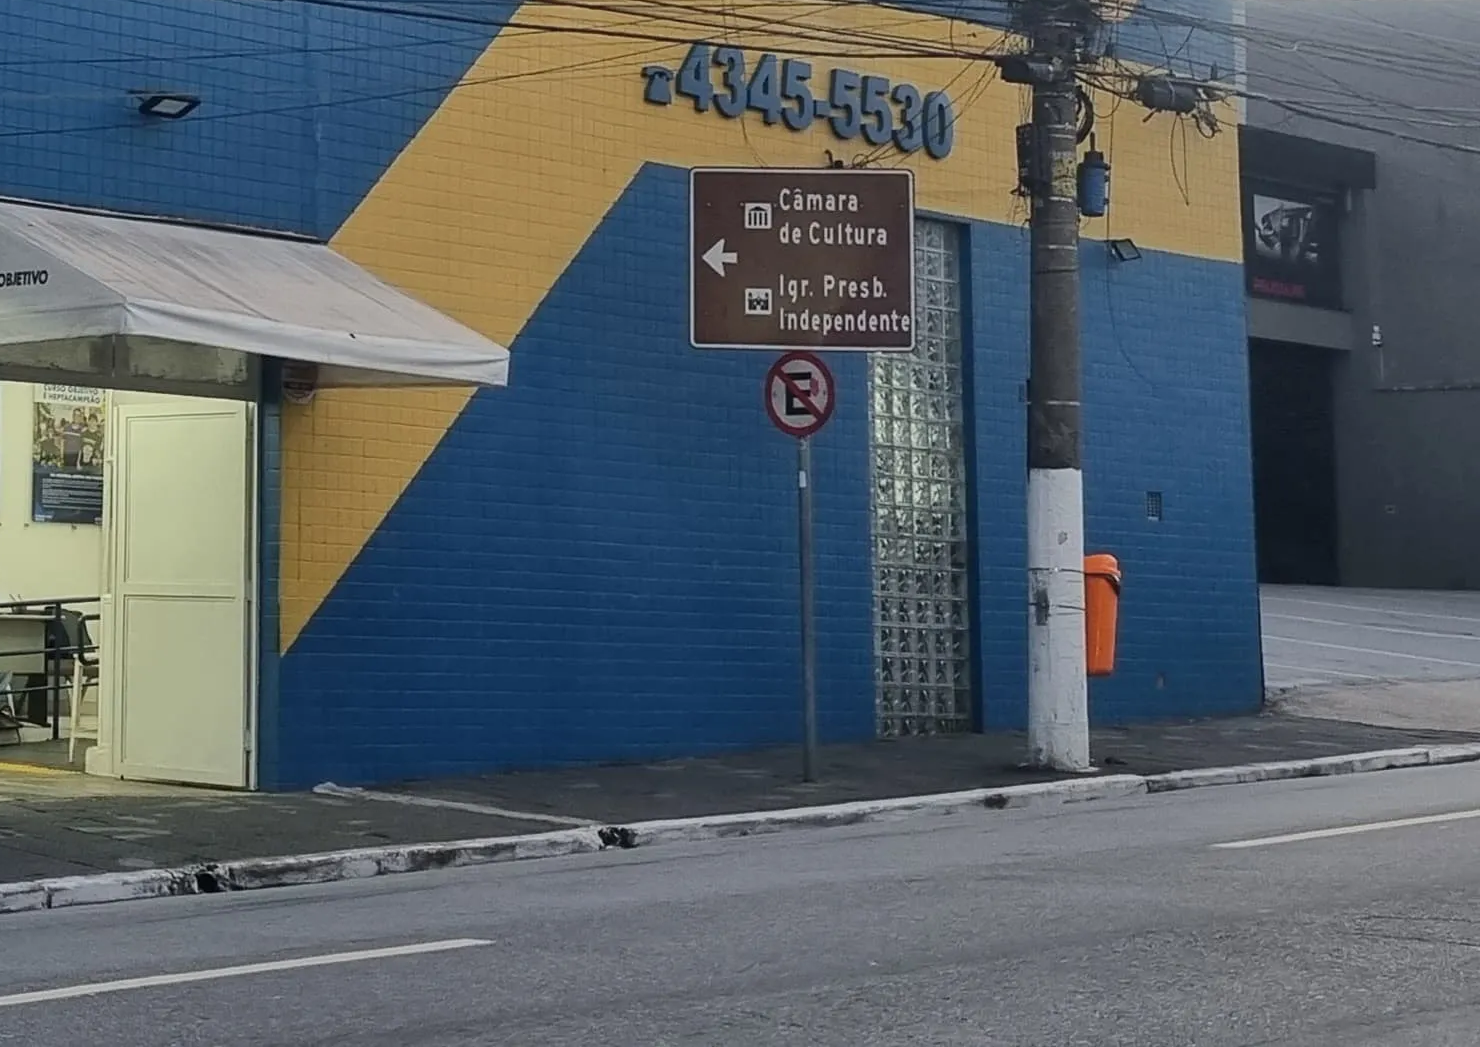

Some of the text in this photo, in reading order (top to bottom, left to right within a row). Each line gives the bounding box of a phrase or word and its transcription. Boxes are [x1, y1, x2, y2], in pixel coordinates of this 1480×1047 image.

[675, 43, 954, 159] 4345-5530
[779, 188, 859, 212] Câmara
[779, 222, 888, 246] de Cultura
[779, 274, 888, 303] Igr. Presb.
[779, 307, 911, 335] Independente
